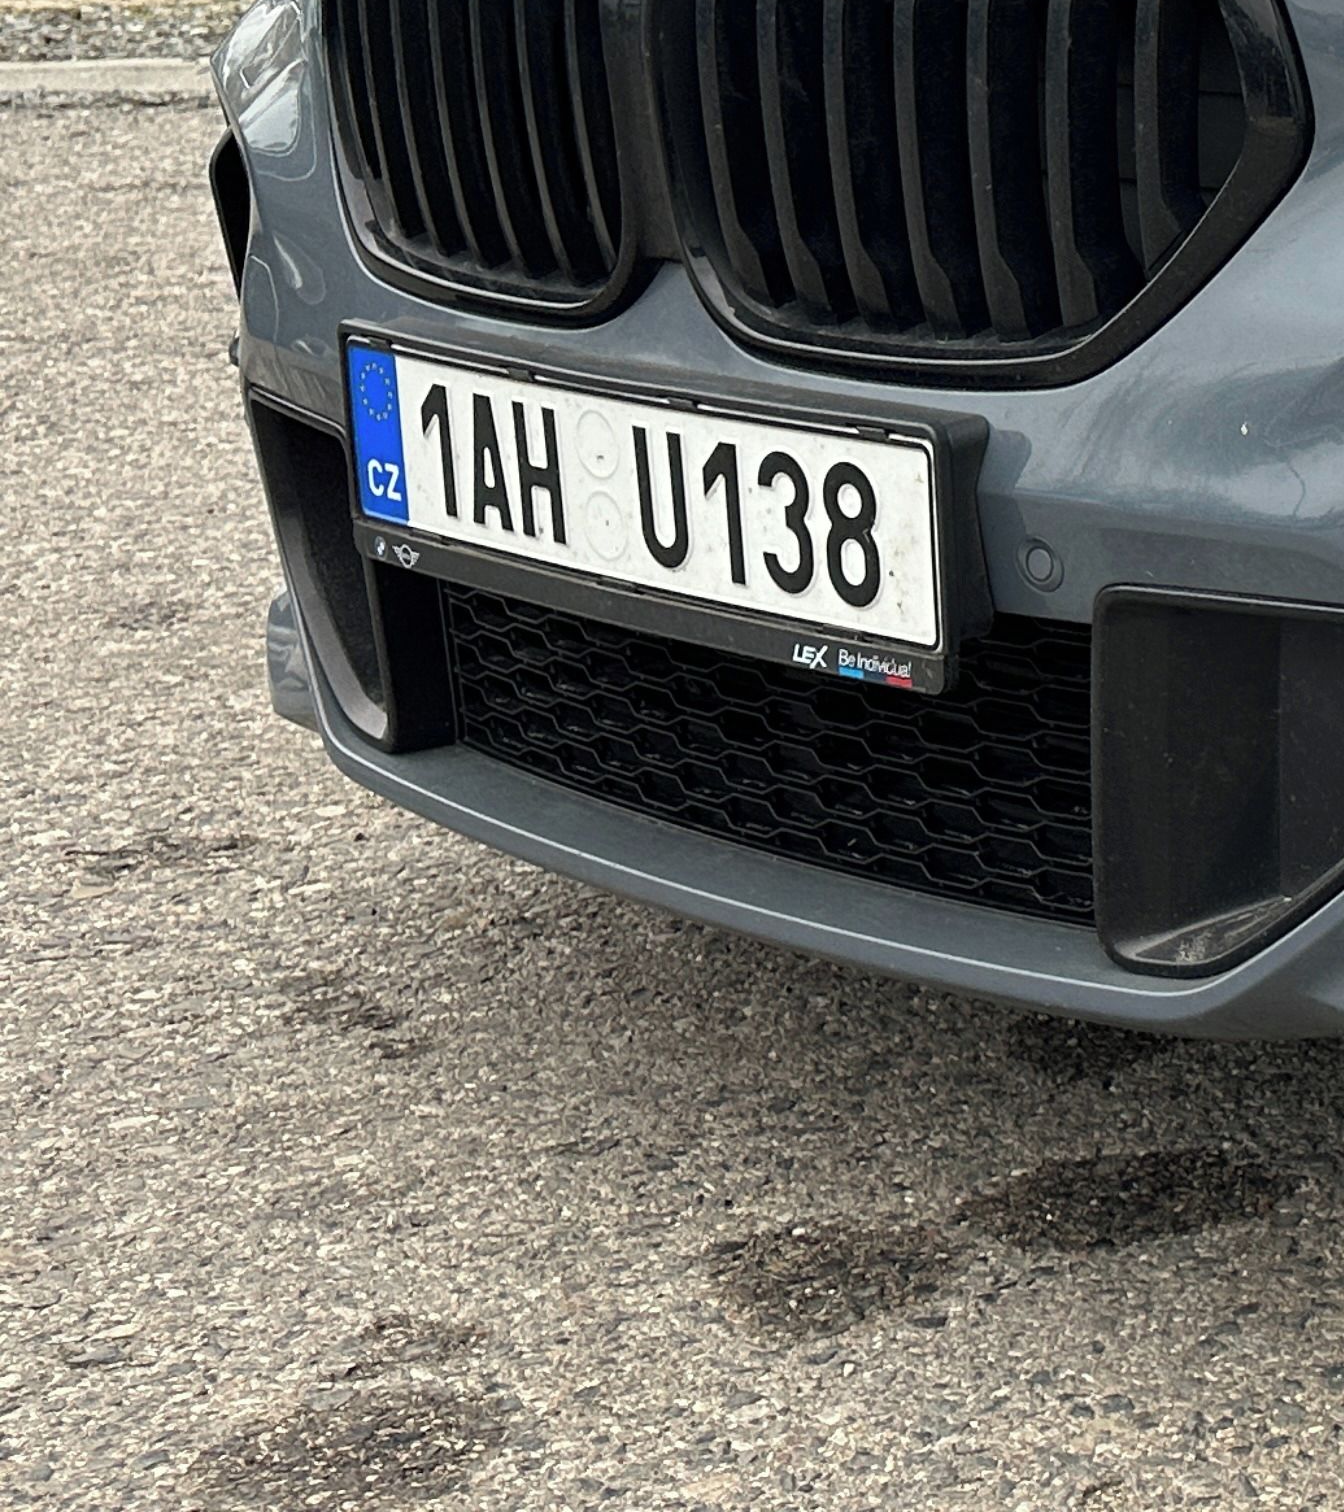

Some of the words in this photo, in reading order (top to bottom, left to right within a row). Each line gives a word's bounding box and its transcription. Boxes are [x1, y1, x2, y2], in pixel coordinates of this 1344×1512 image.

[368, 458, 402, 502] CZ
[420, 383, 567, 545] 1AH
[632, 425, 882, 608] U138
[792, 643, 828, 669] LEX
